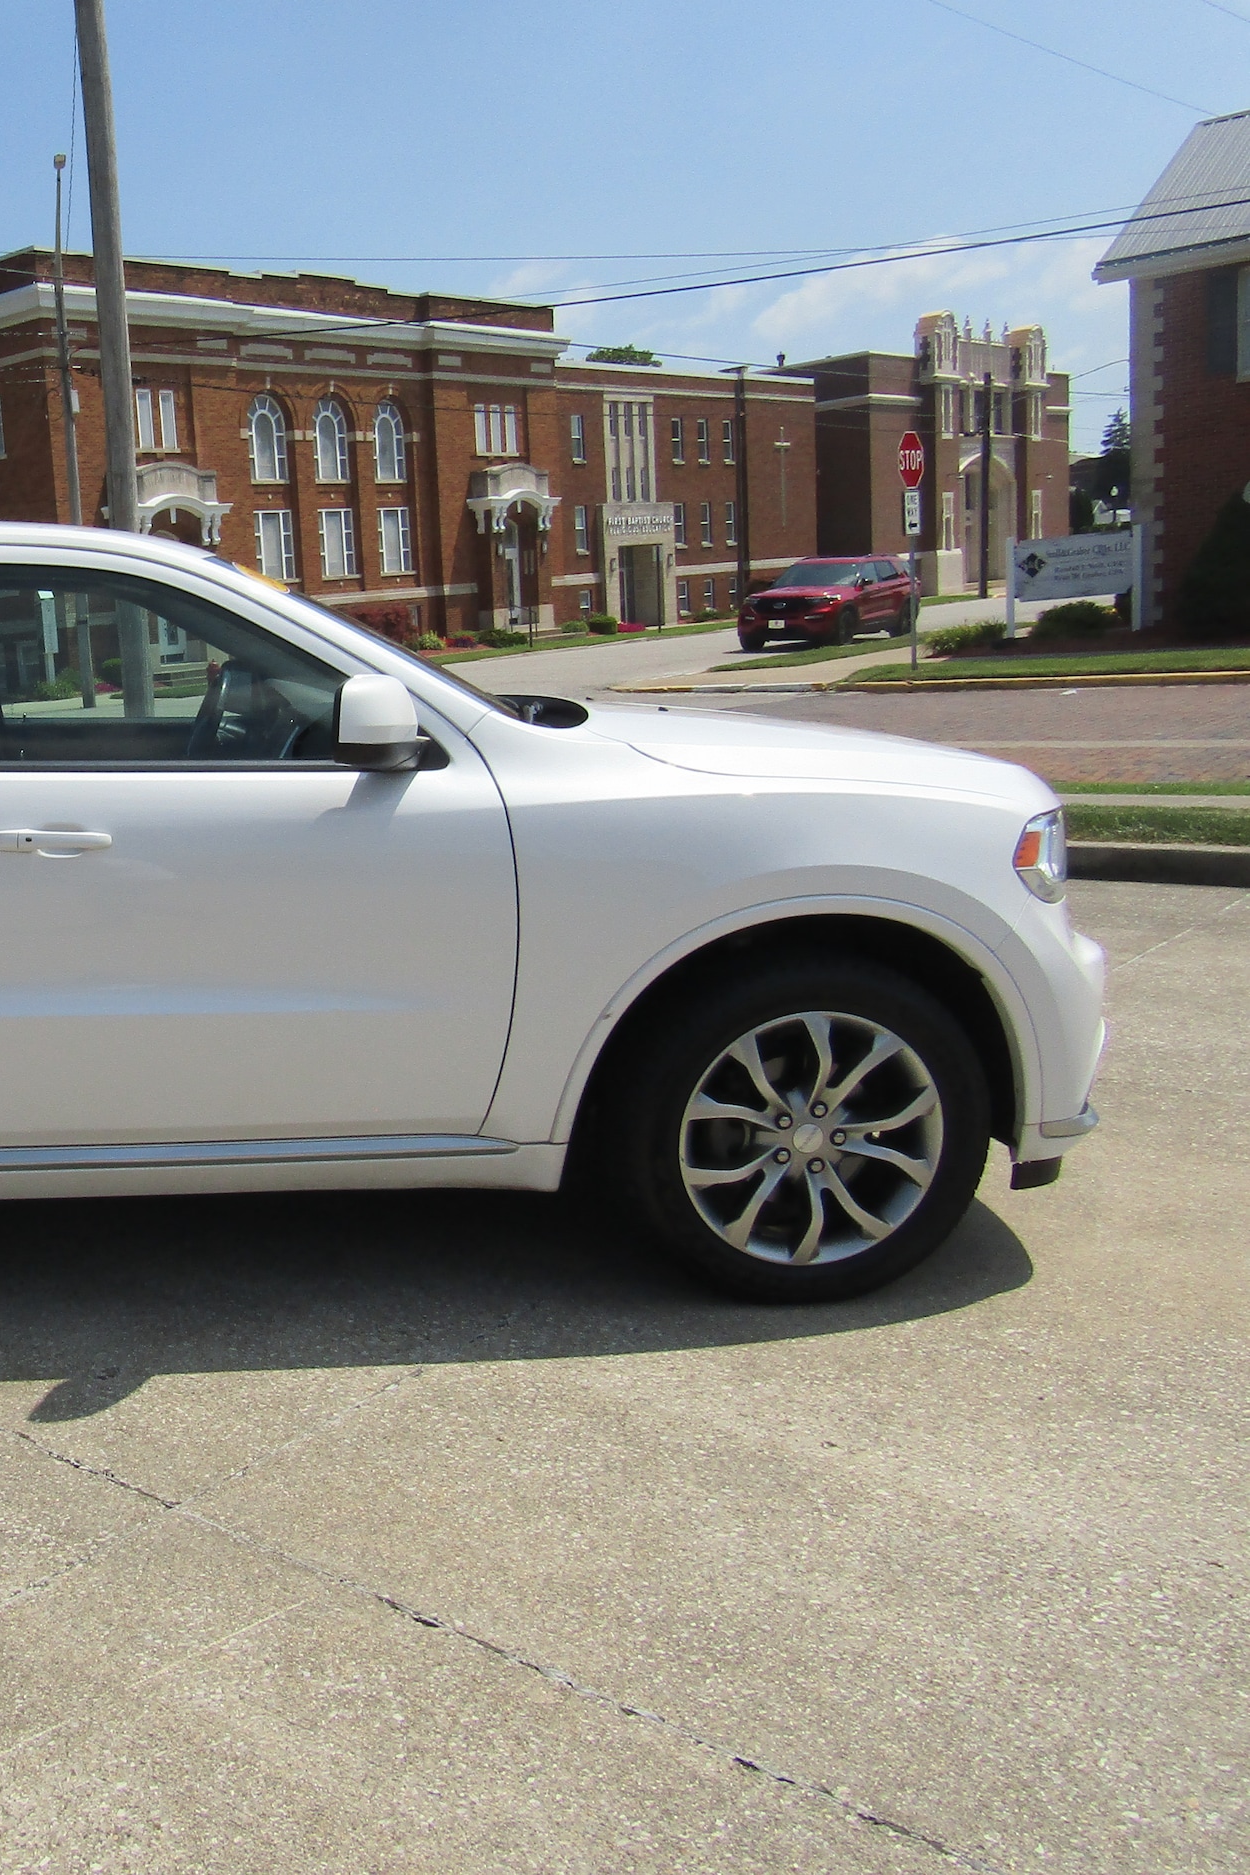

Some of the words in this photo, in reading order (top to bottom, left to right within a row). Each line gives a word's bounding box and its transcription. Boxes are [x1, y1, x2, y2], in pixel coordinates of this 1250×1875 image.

[900, 450, 922, 470] STOP
[906, 494, 917, 506] ONE
[907, 507, 918, 517] WAY
[608, 517, 625, 526] FIRST
[628, 516, 651, 525] BAPTIST
